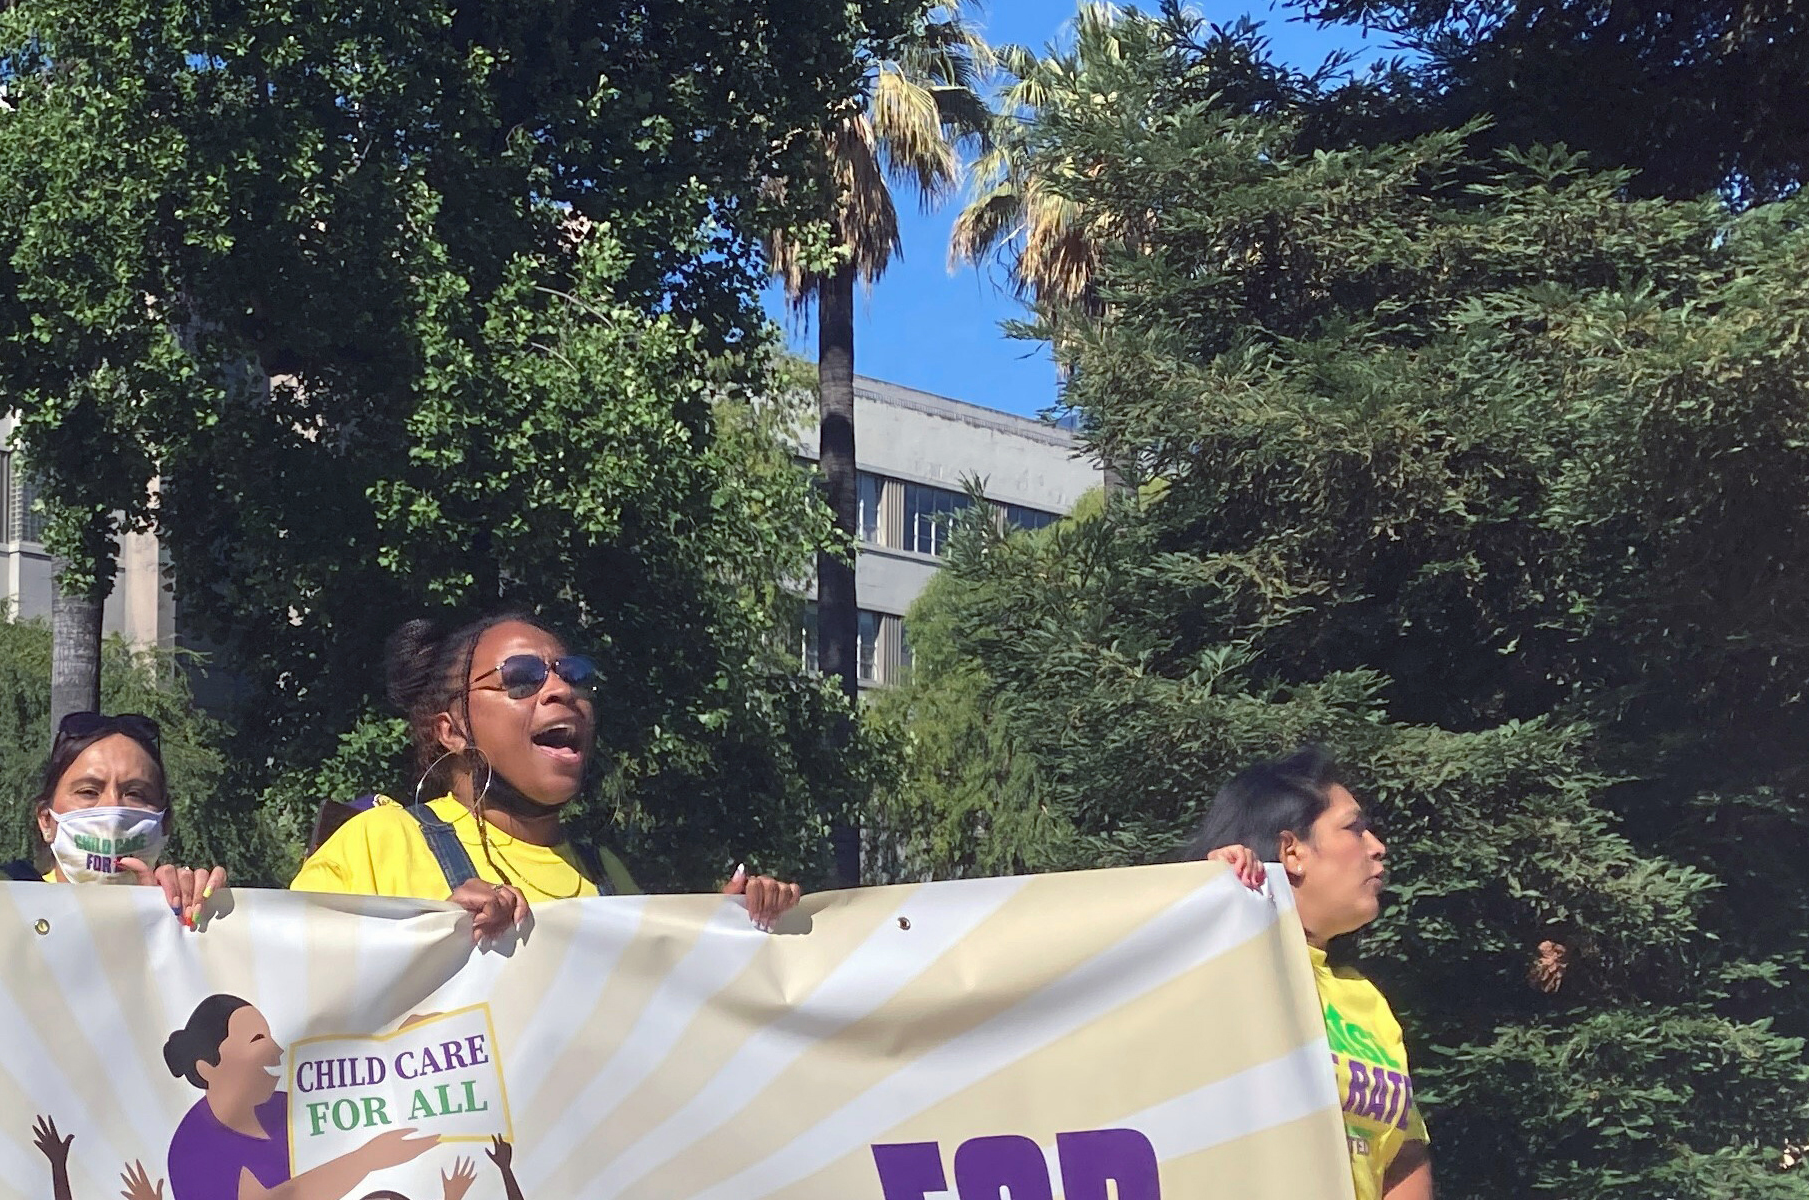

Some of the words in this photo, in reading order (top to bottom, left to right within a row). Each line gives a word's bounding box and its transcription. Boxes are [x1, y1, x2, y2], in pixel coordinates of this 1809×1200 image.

[87, 853, 111, 873] FOR
[296, 1056, 386, 1093] CHILD
[394, 1034, 489, 1080] CARE
[306, 1097, 392, 1136] FOR
[408, 1080, 488, 1120] ALL
